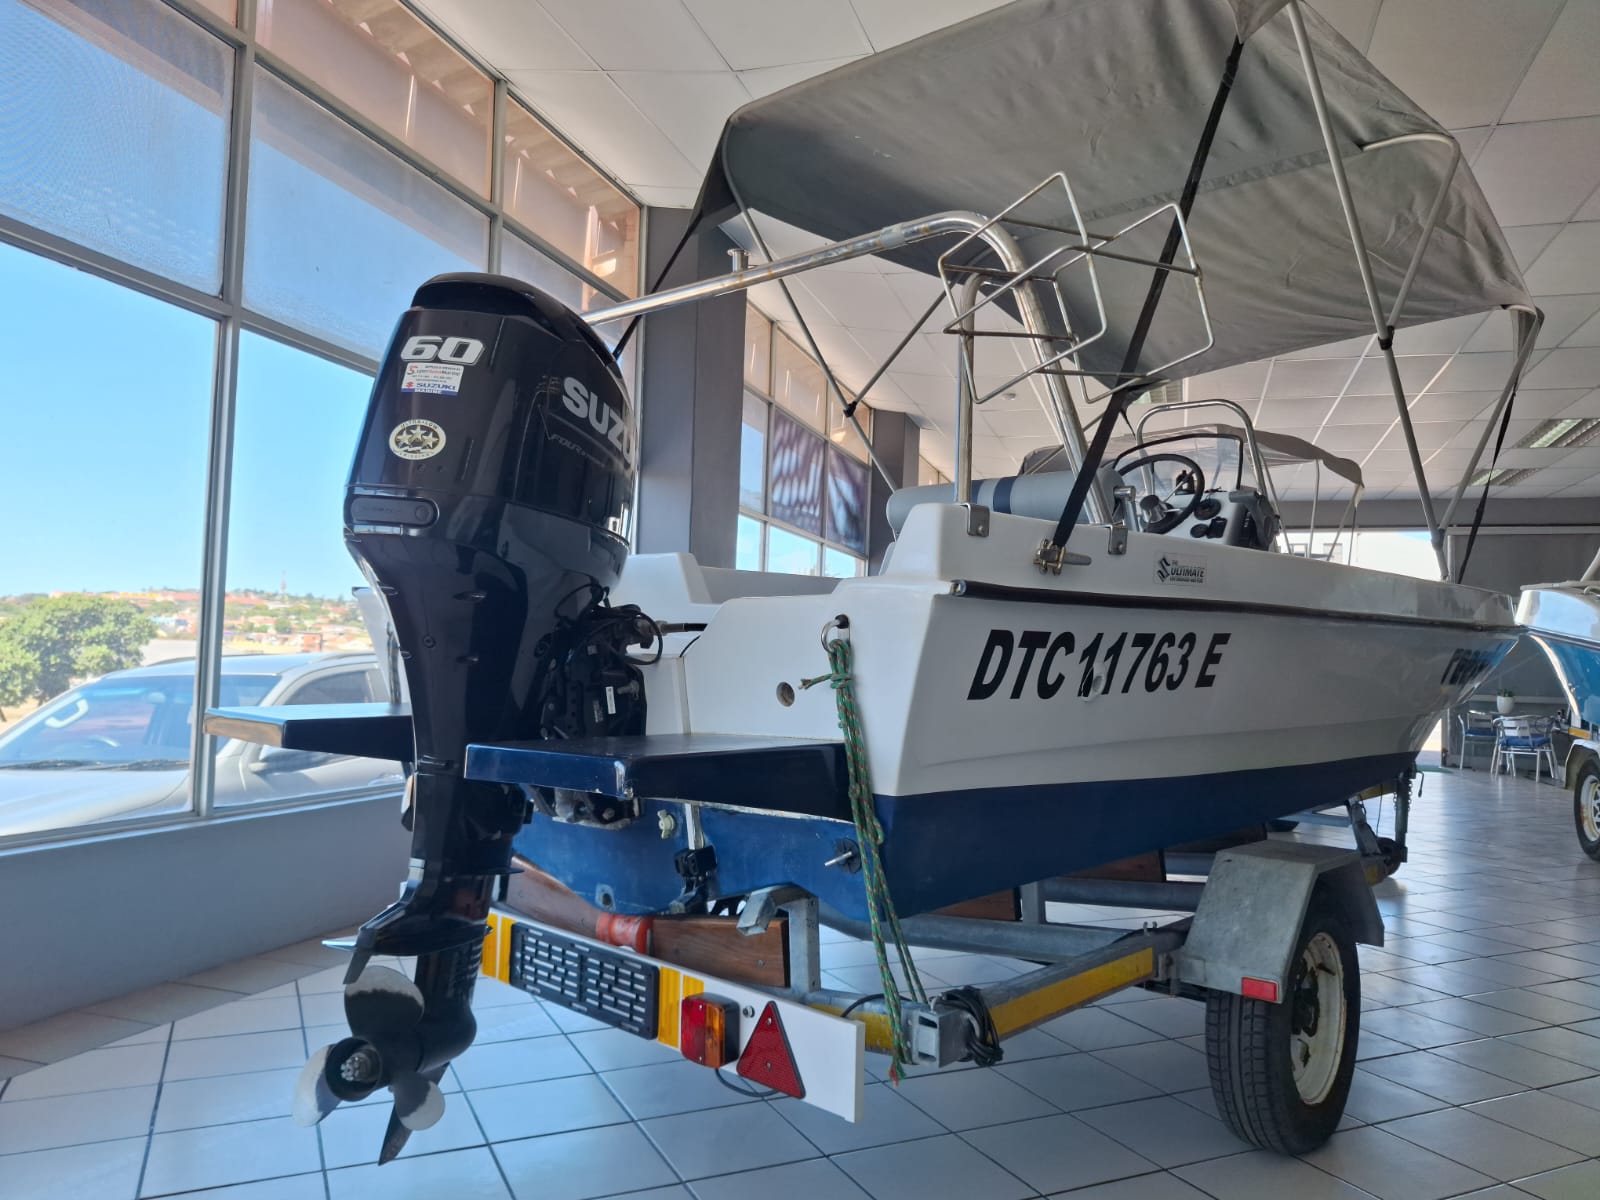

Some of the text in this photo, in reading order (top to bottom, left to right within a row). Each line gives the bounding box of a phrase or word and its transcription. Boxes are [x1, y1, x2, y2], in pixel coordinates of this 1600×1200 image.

[401, 335, 485, 366] 60
[1170, 567, 1205, 578] ULTIMATE
[1194, 632, 1232, 688] E
